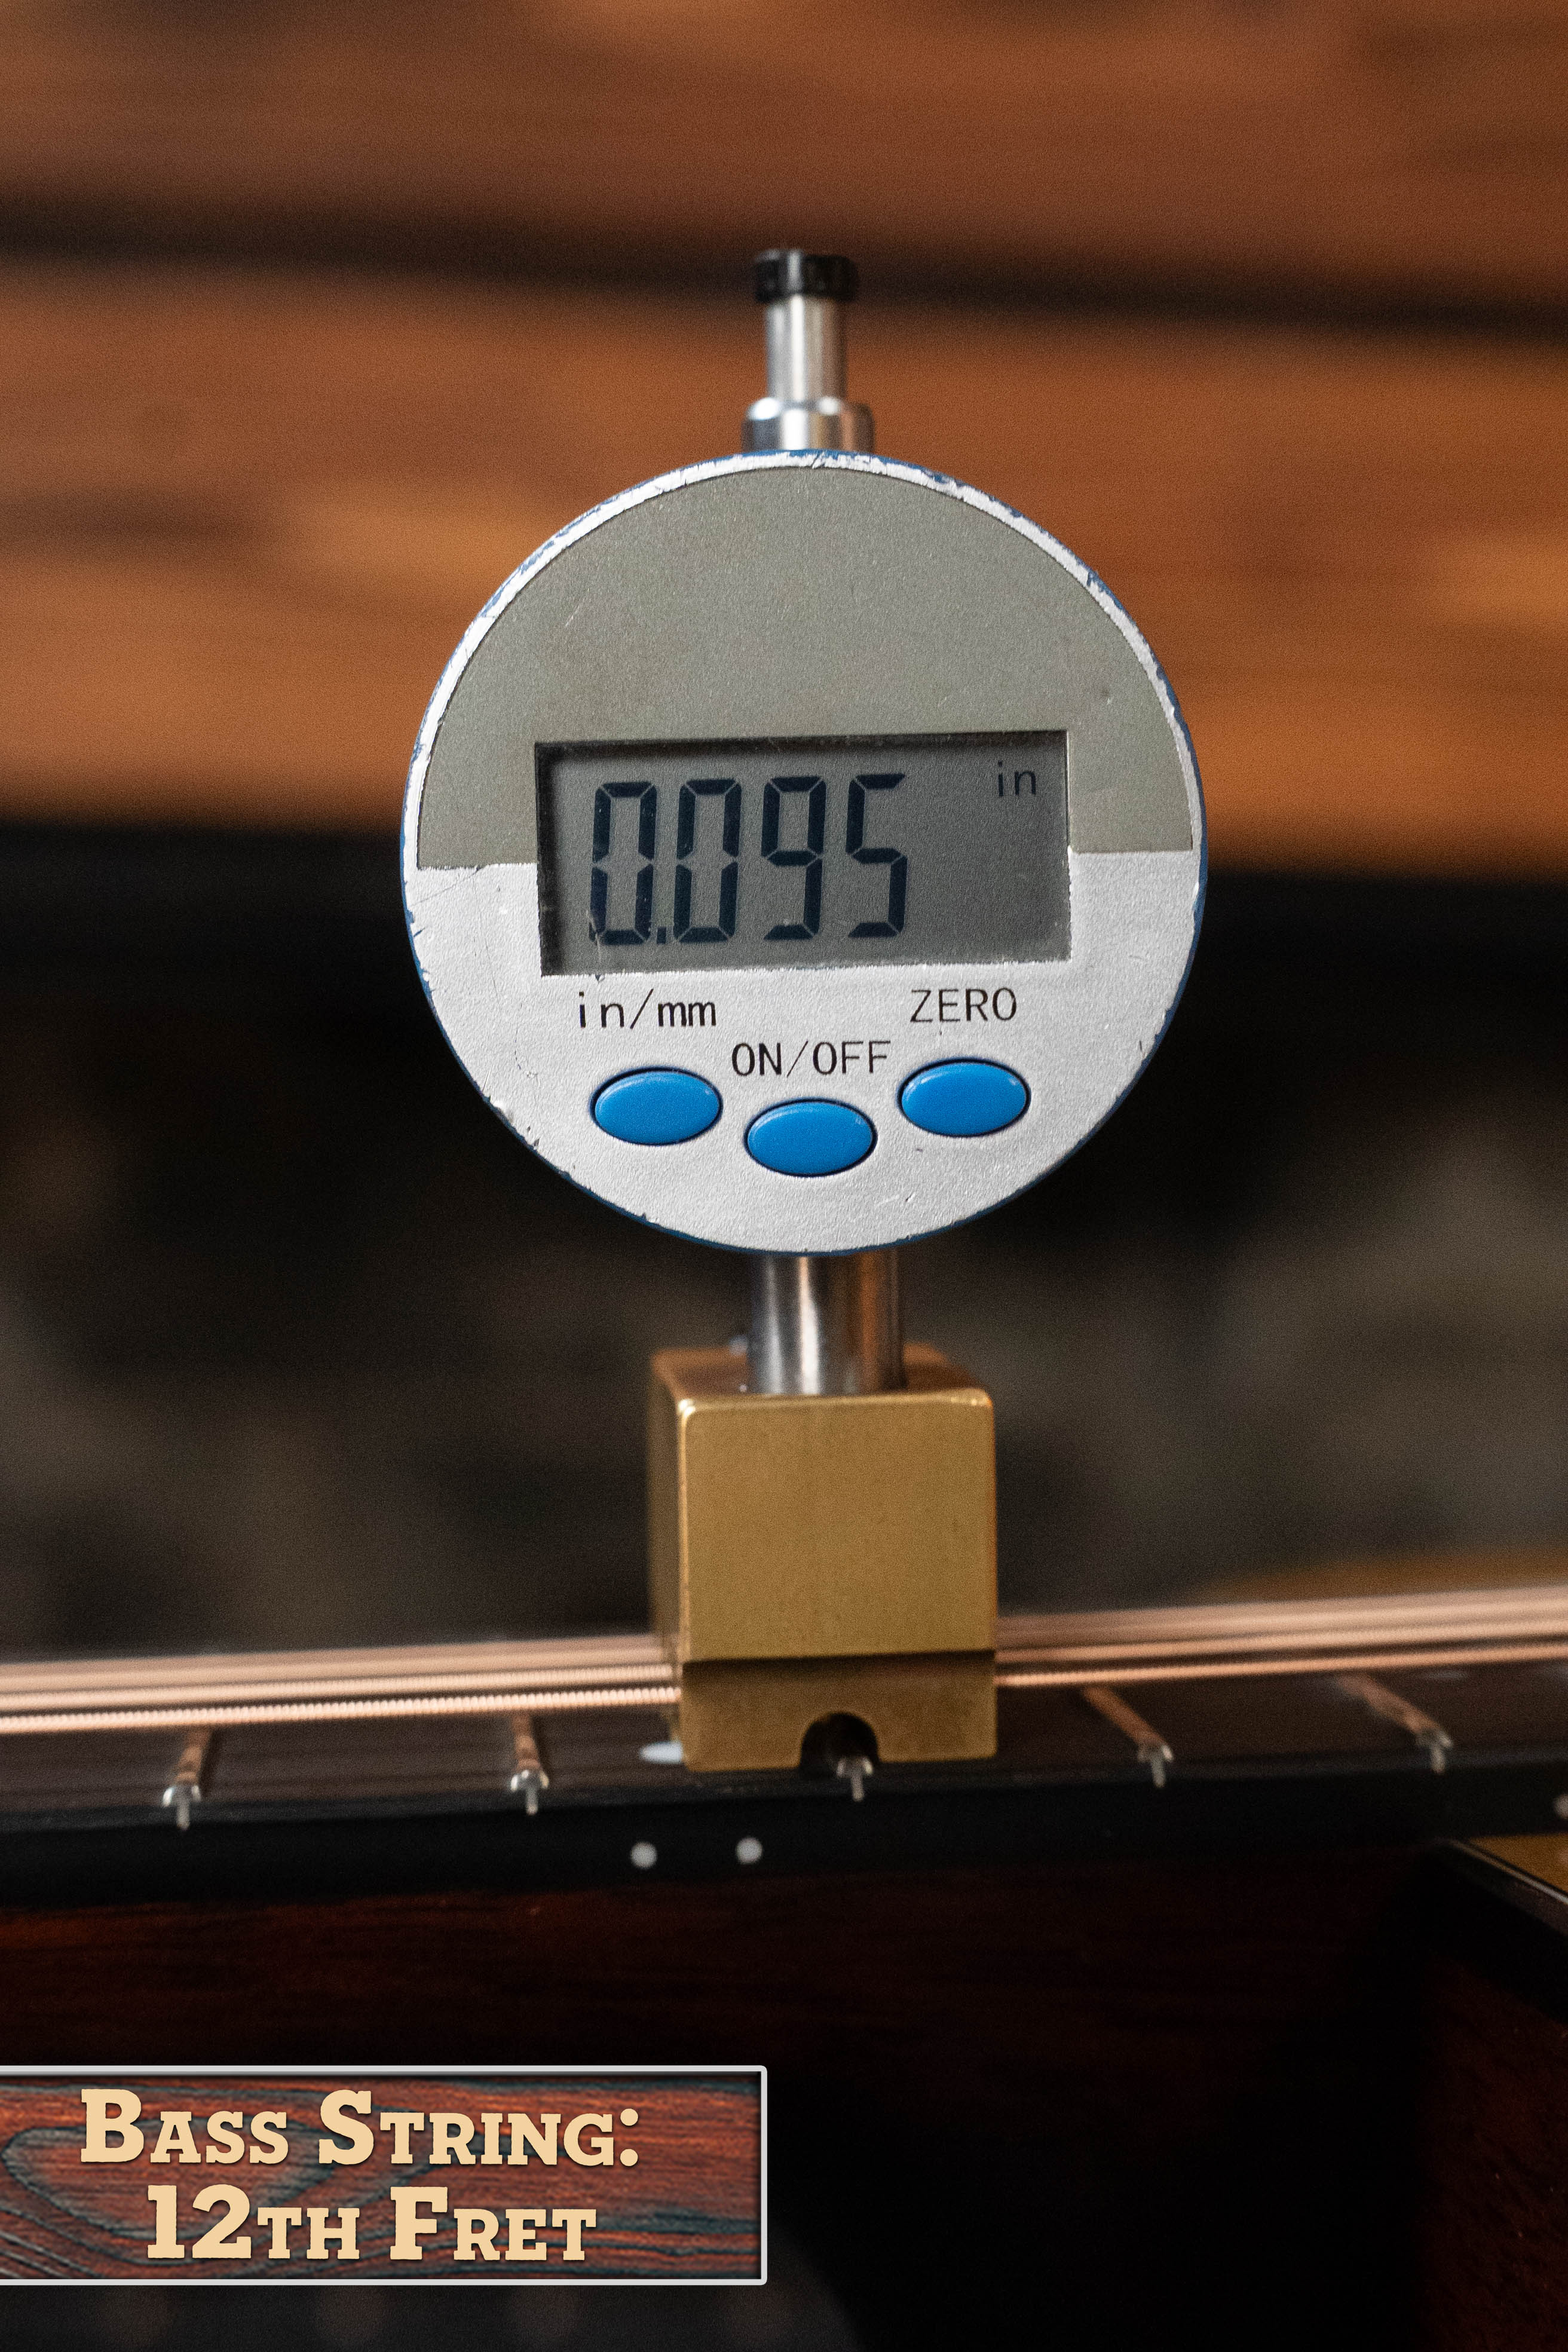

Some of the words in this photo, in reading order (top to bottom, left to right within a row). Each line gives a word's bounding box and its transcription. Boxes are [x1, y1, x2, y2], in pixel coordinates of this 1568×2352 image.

[589, 773, 908, 945] 0.095
[996, 760, 1038, 798] in
[578, 988, 717, 1029] in/mm
[909, 987, 1018, 1024] ZERO
[731, 1040, 892, 1077] ON/OFF
